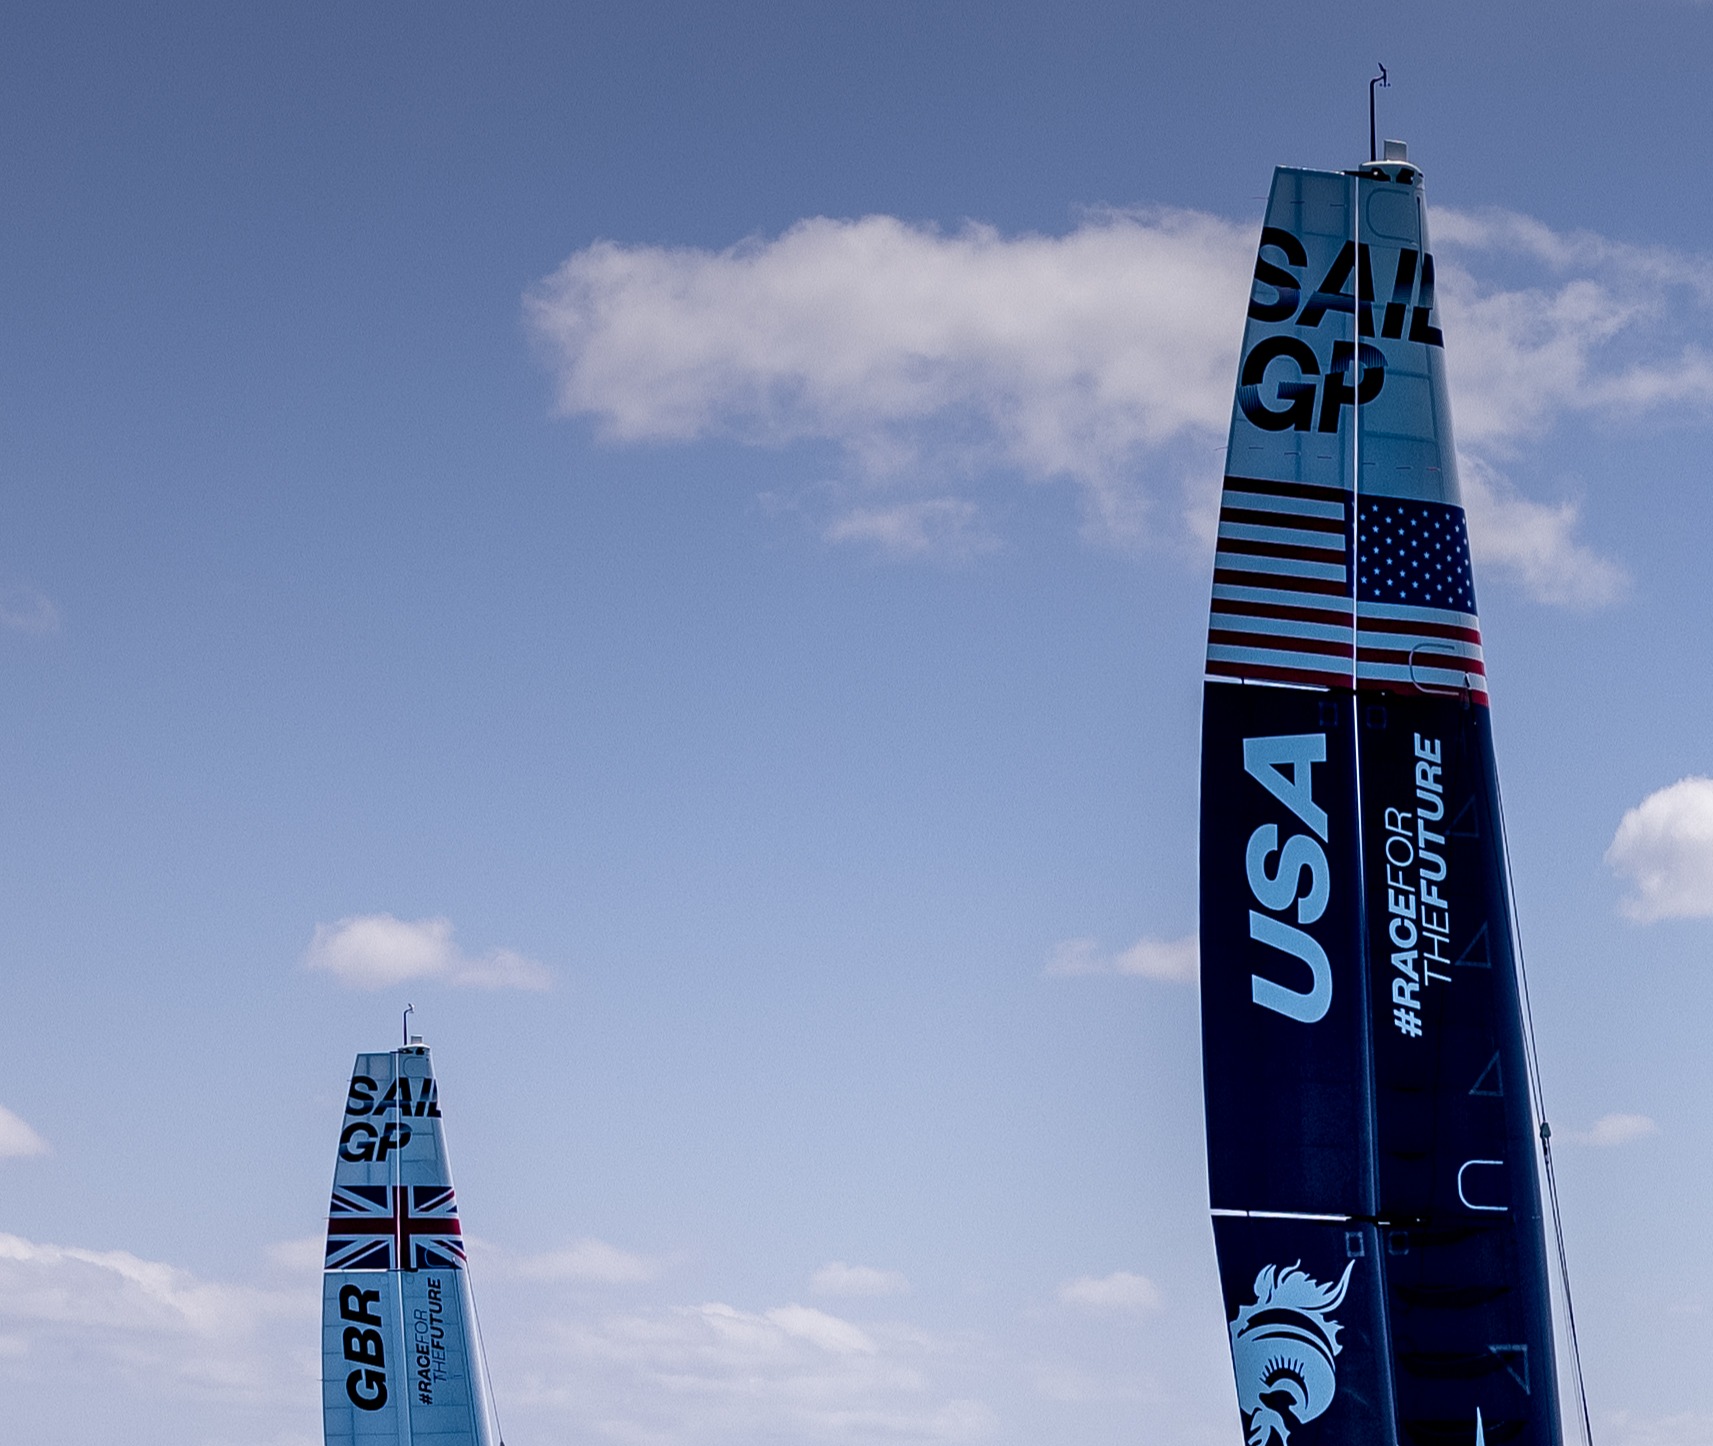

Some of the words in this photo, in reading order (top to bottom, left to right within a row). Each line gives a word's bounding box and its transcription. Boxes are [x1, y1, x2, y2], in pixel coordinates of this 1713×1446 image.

[1248, 226, 1444, 348] SAIL
[1236, 335, 1387, 434] GP
[1243, 733, 1332, 1023] USA
[1414, 733, 1452, 986] THEFUTURE
[1385, 807, 1423, 1038] #RACEFOR
[339, 1122, 412, 1162] GP
[344, 1075, 442, 1118] SAIL
[339, 1284, 388, 1411] GBR
[414, 1309, 433, 1406] #RACEFOR
[427, 1277, 447, 1383] THEFUTURE
